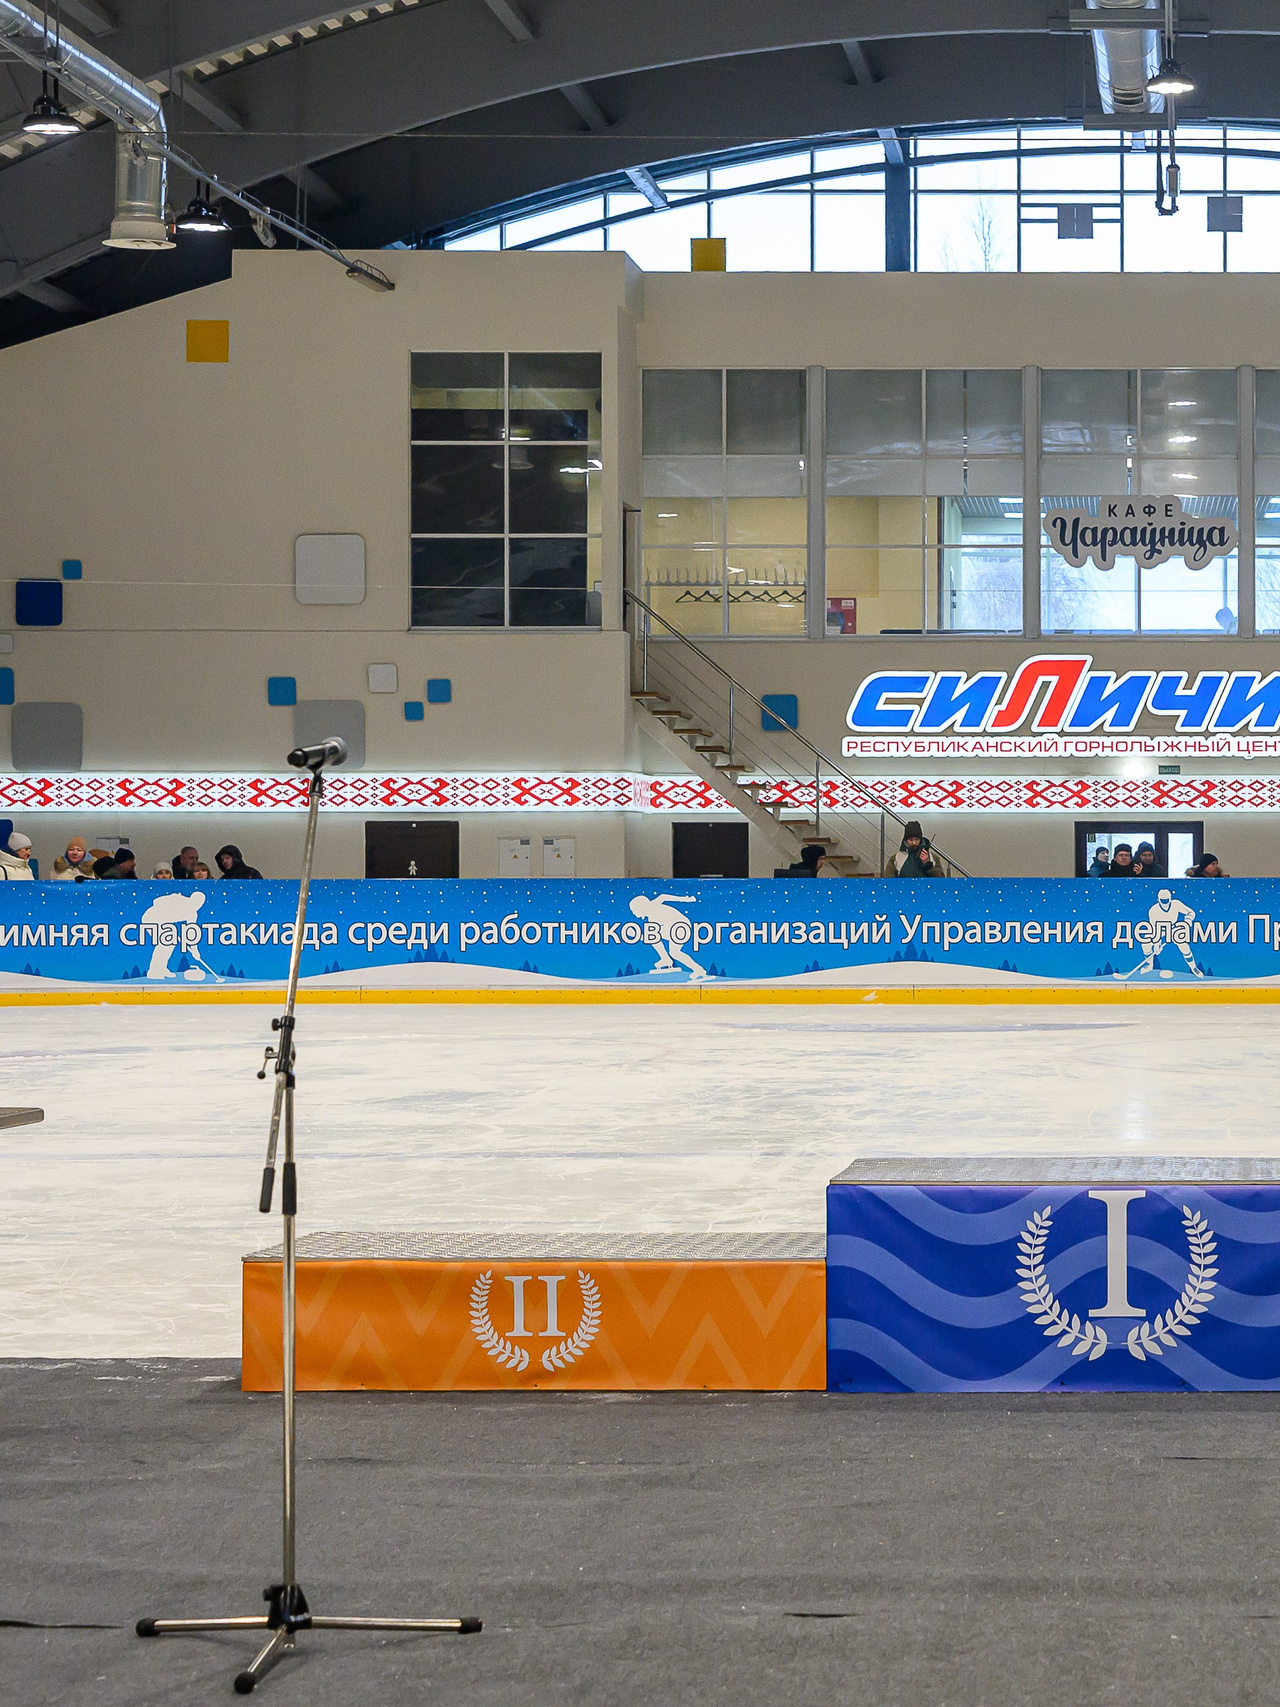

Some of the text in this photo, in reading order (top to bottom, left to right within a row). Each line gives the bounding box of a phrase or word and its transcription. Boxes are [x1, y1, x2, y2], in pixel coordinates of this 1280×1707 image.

[1107, 503, 1174, 518] КАФЕ
[1051, 516, 1230, 562] Чараўніца
[846, 738, 1058, 753] РЕСПУБЛИКАНСКИЙ
[1063, 738, 1231, 753] ГОРНОЛЫЖНЫЙ
[119, 921, 339, 953] спартакиада
[347, 920, 450, 952] среди
[459, 912, 662, 952] работников
[669, 914, 892, 952] организаций
[899, 913, 1104, 951] Управления
[1112, 920, 1237, 949] делами
